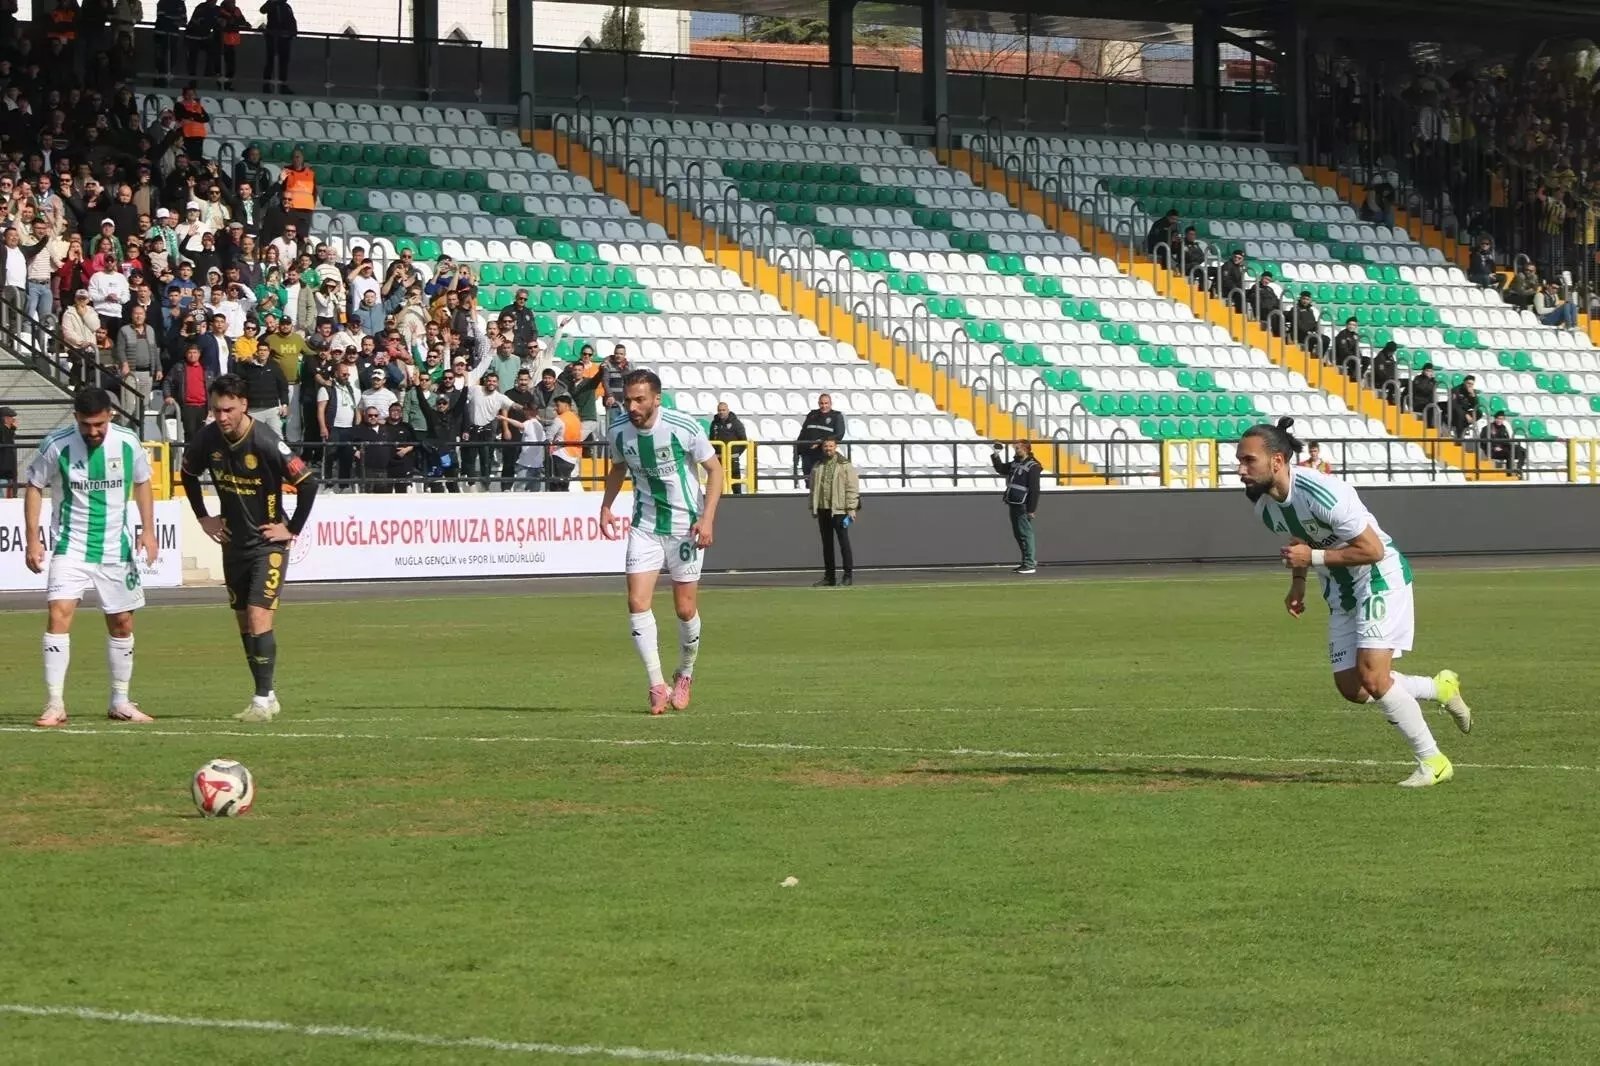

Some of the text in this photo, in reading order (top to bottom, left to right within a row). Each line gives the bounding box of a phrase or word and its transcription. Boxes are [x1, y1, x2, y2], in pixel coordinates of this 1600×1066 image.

[70, 479, 122, 490] mikroman
[317, 514, 490, 546] MUĞLASPOR'UMUZA
[495, 516, 583, 548] BAŞARILAR
[395, 555, 423, 566] MUĞLA
[425, 555, 457, 566] GENÇLİK
[468, 554, 488, 564] SPOR
[497, 552, 545, 564] MÜDÜRLÜĞÜ
[265, 568, 280, 589] 3
[1361, 596, 1386, 621] 10
